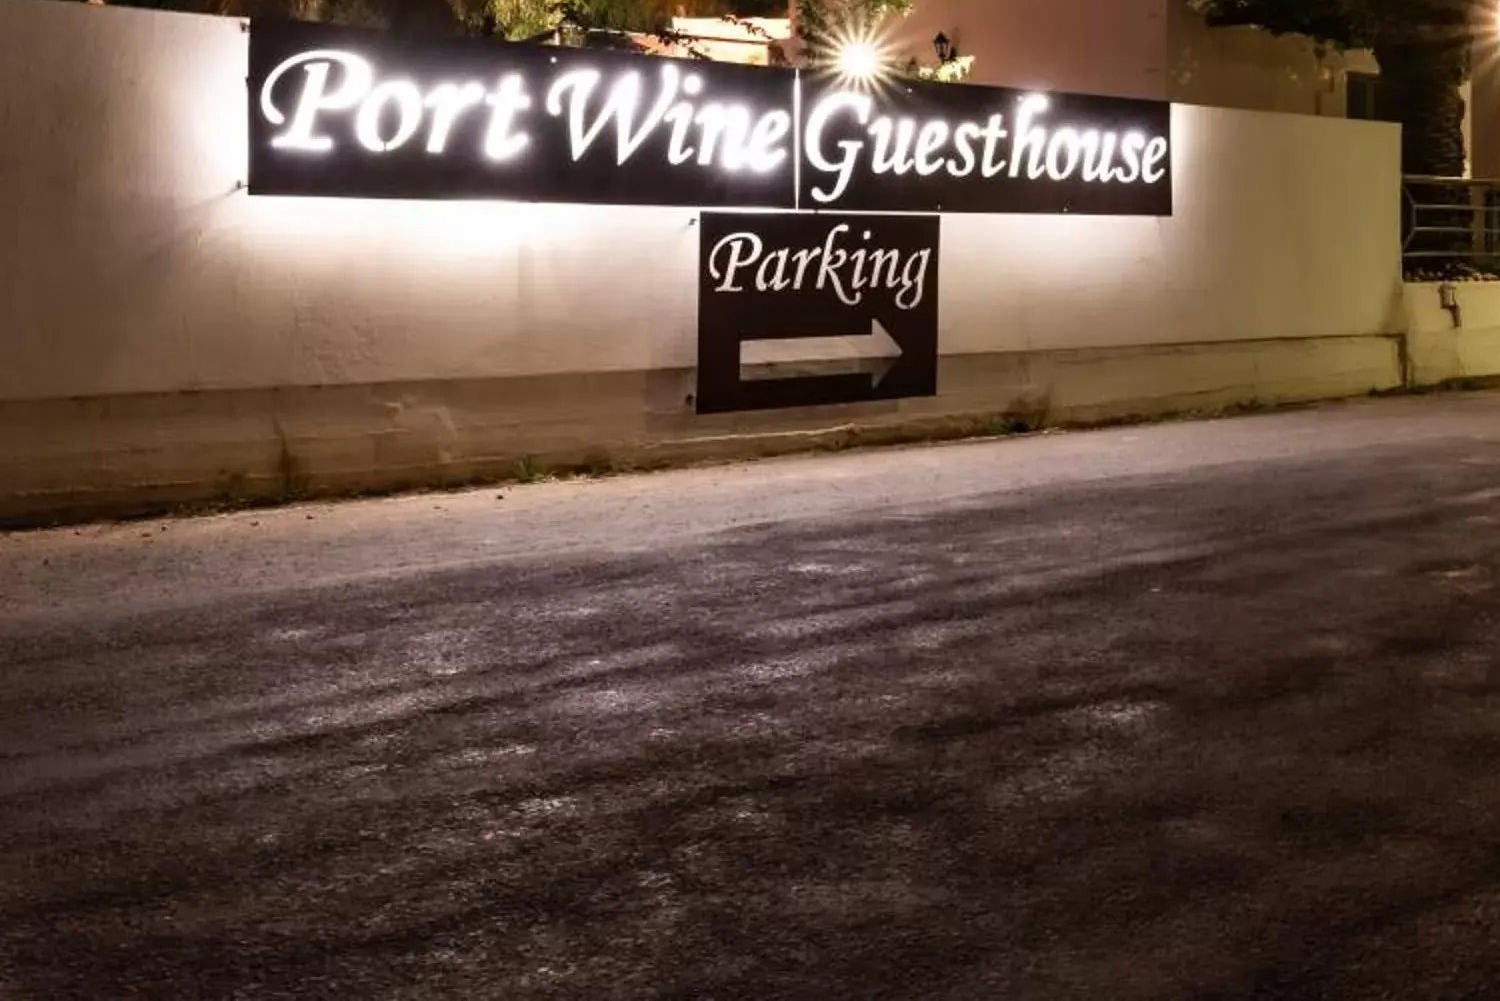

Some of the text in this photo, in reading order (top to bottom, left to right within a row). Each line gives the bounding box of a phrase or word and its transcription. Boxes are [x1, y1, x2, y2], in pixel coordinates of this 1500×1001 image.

[260, 48, 1168, 203] Port Wine Guesthouse
[708, 223, 932, 310] Parking
